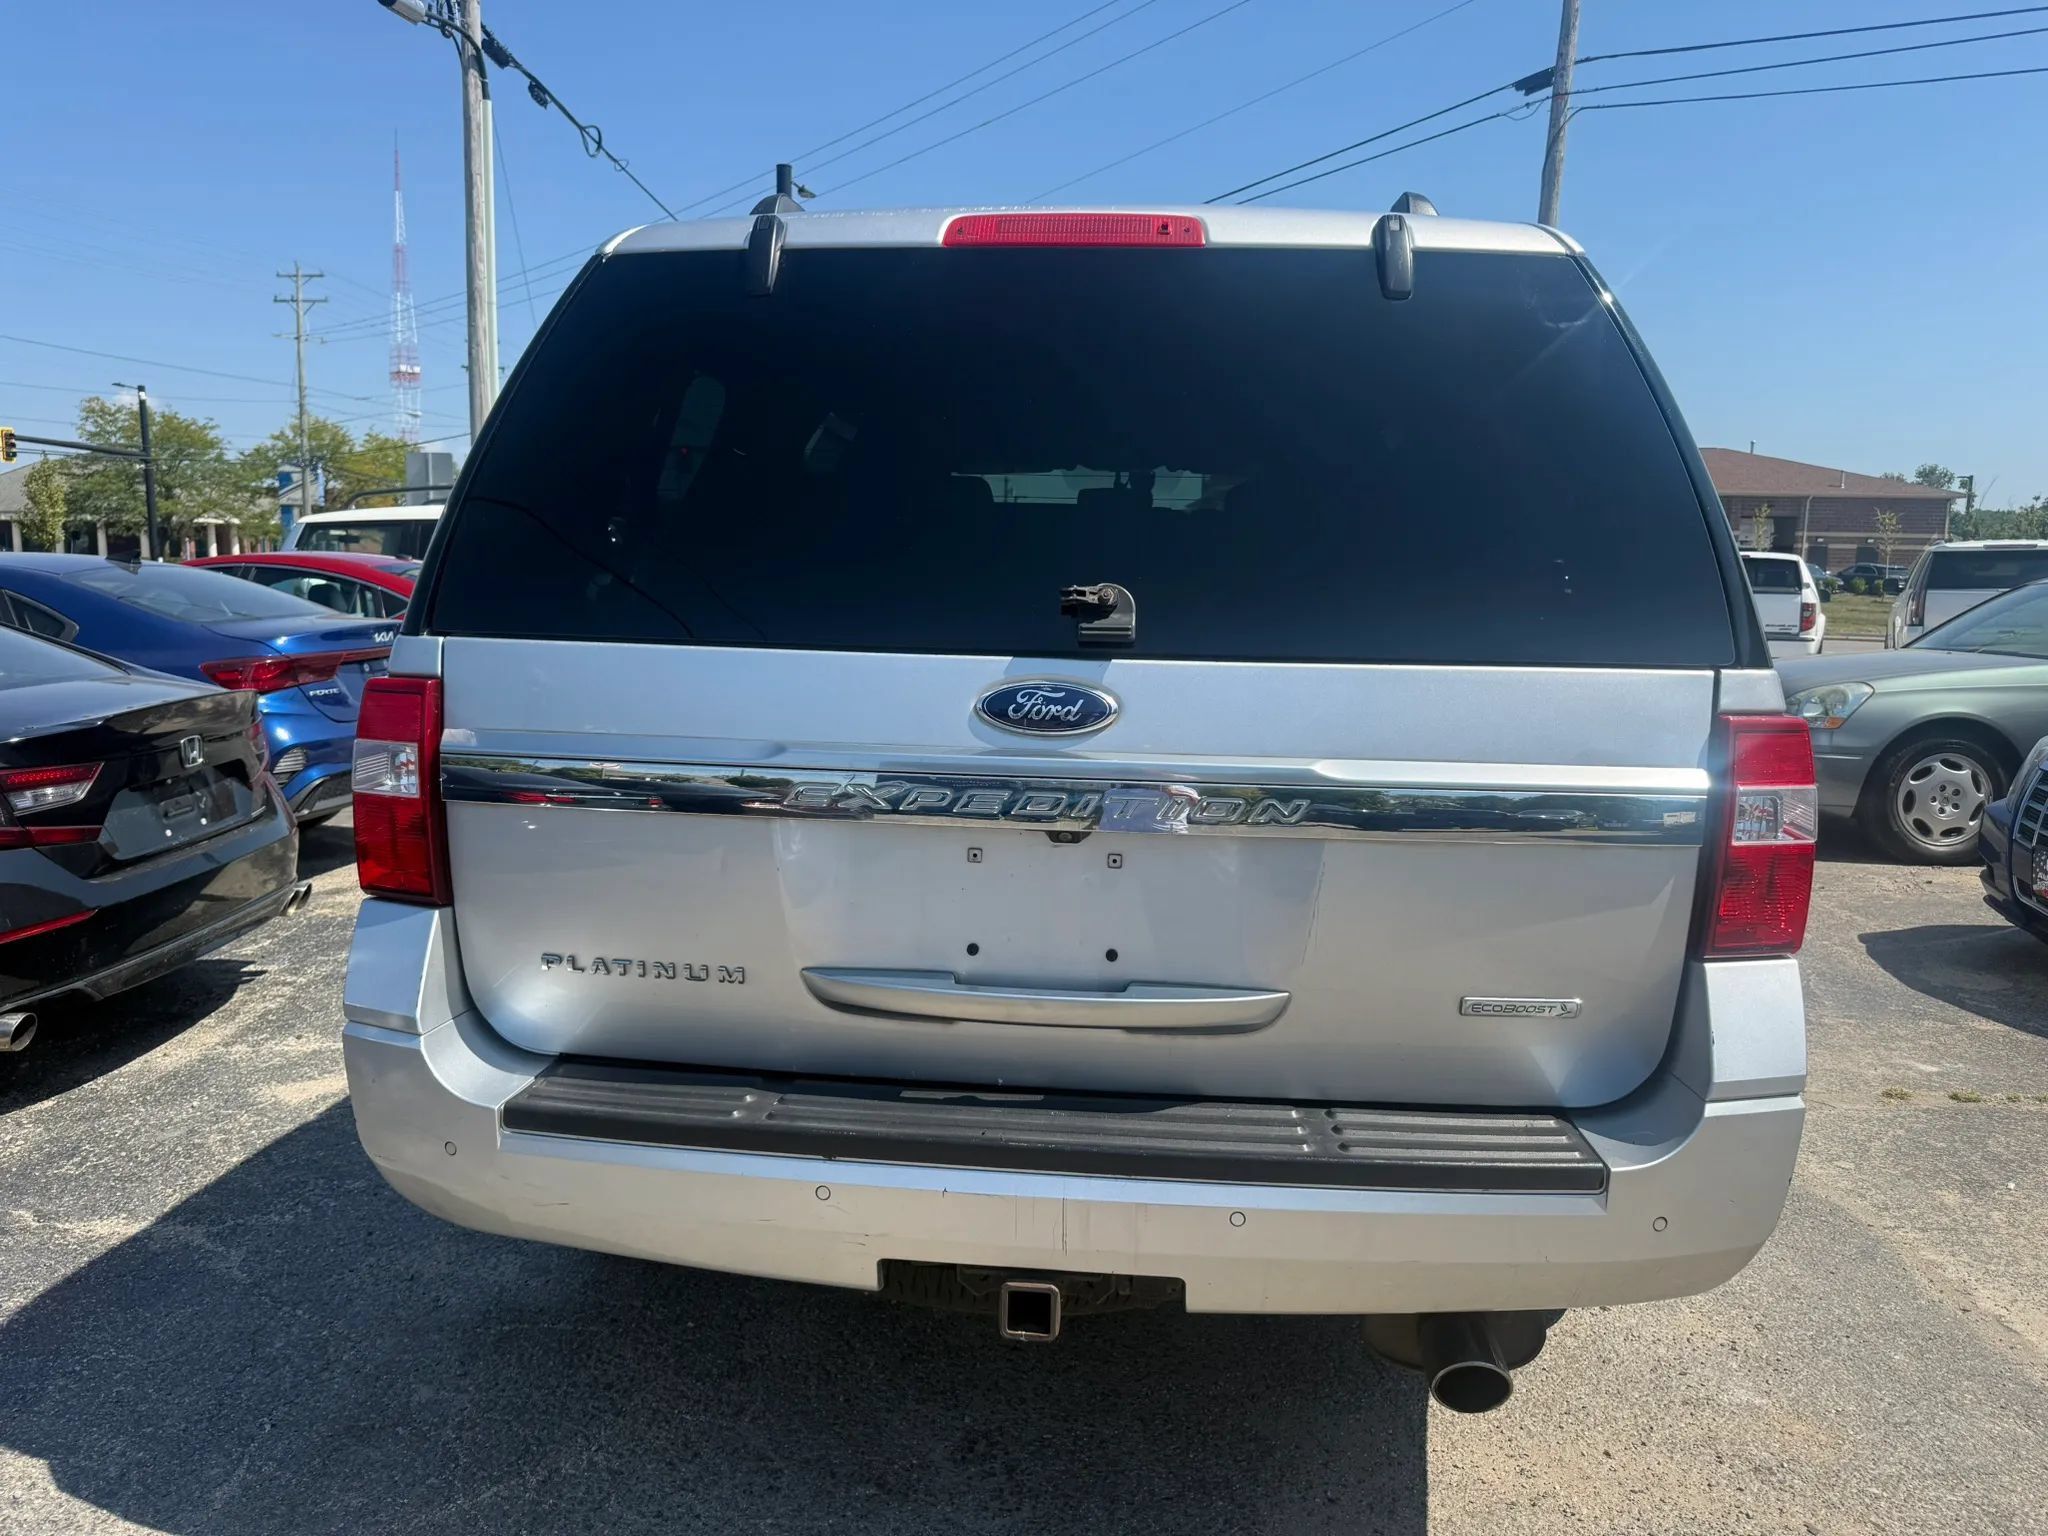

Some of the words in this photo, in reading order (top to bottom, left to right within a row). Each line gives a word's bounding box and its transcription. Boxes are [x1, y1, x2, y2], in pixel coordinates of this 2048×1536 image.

[374, 631, 394, 642] KIA
[1008, 689, 1084, 721] Ford
[783, 781, 1311, 825] EXPEDITION
[540, 953, 746, 984] PLATINUM
[1471, 1003, 1557, 1014] ECOBOOST
